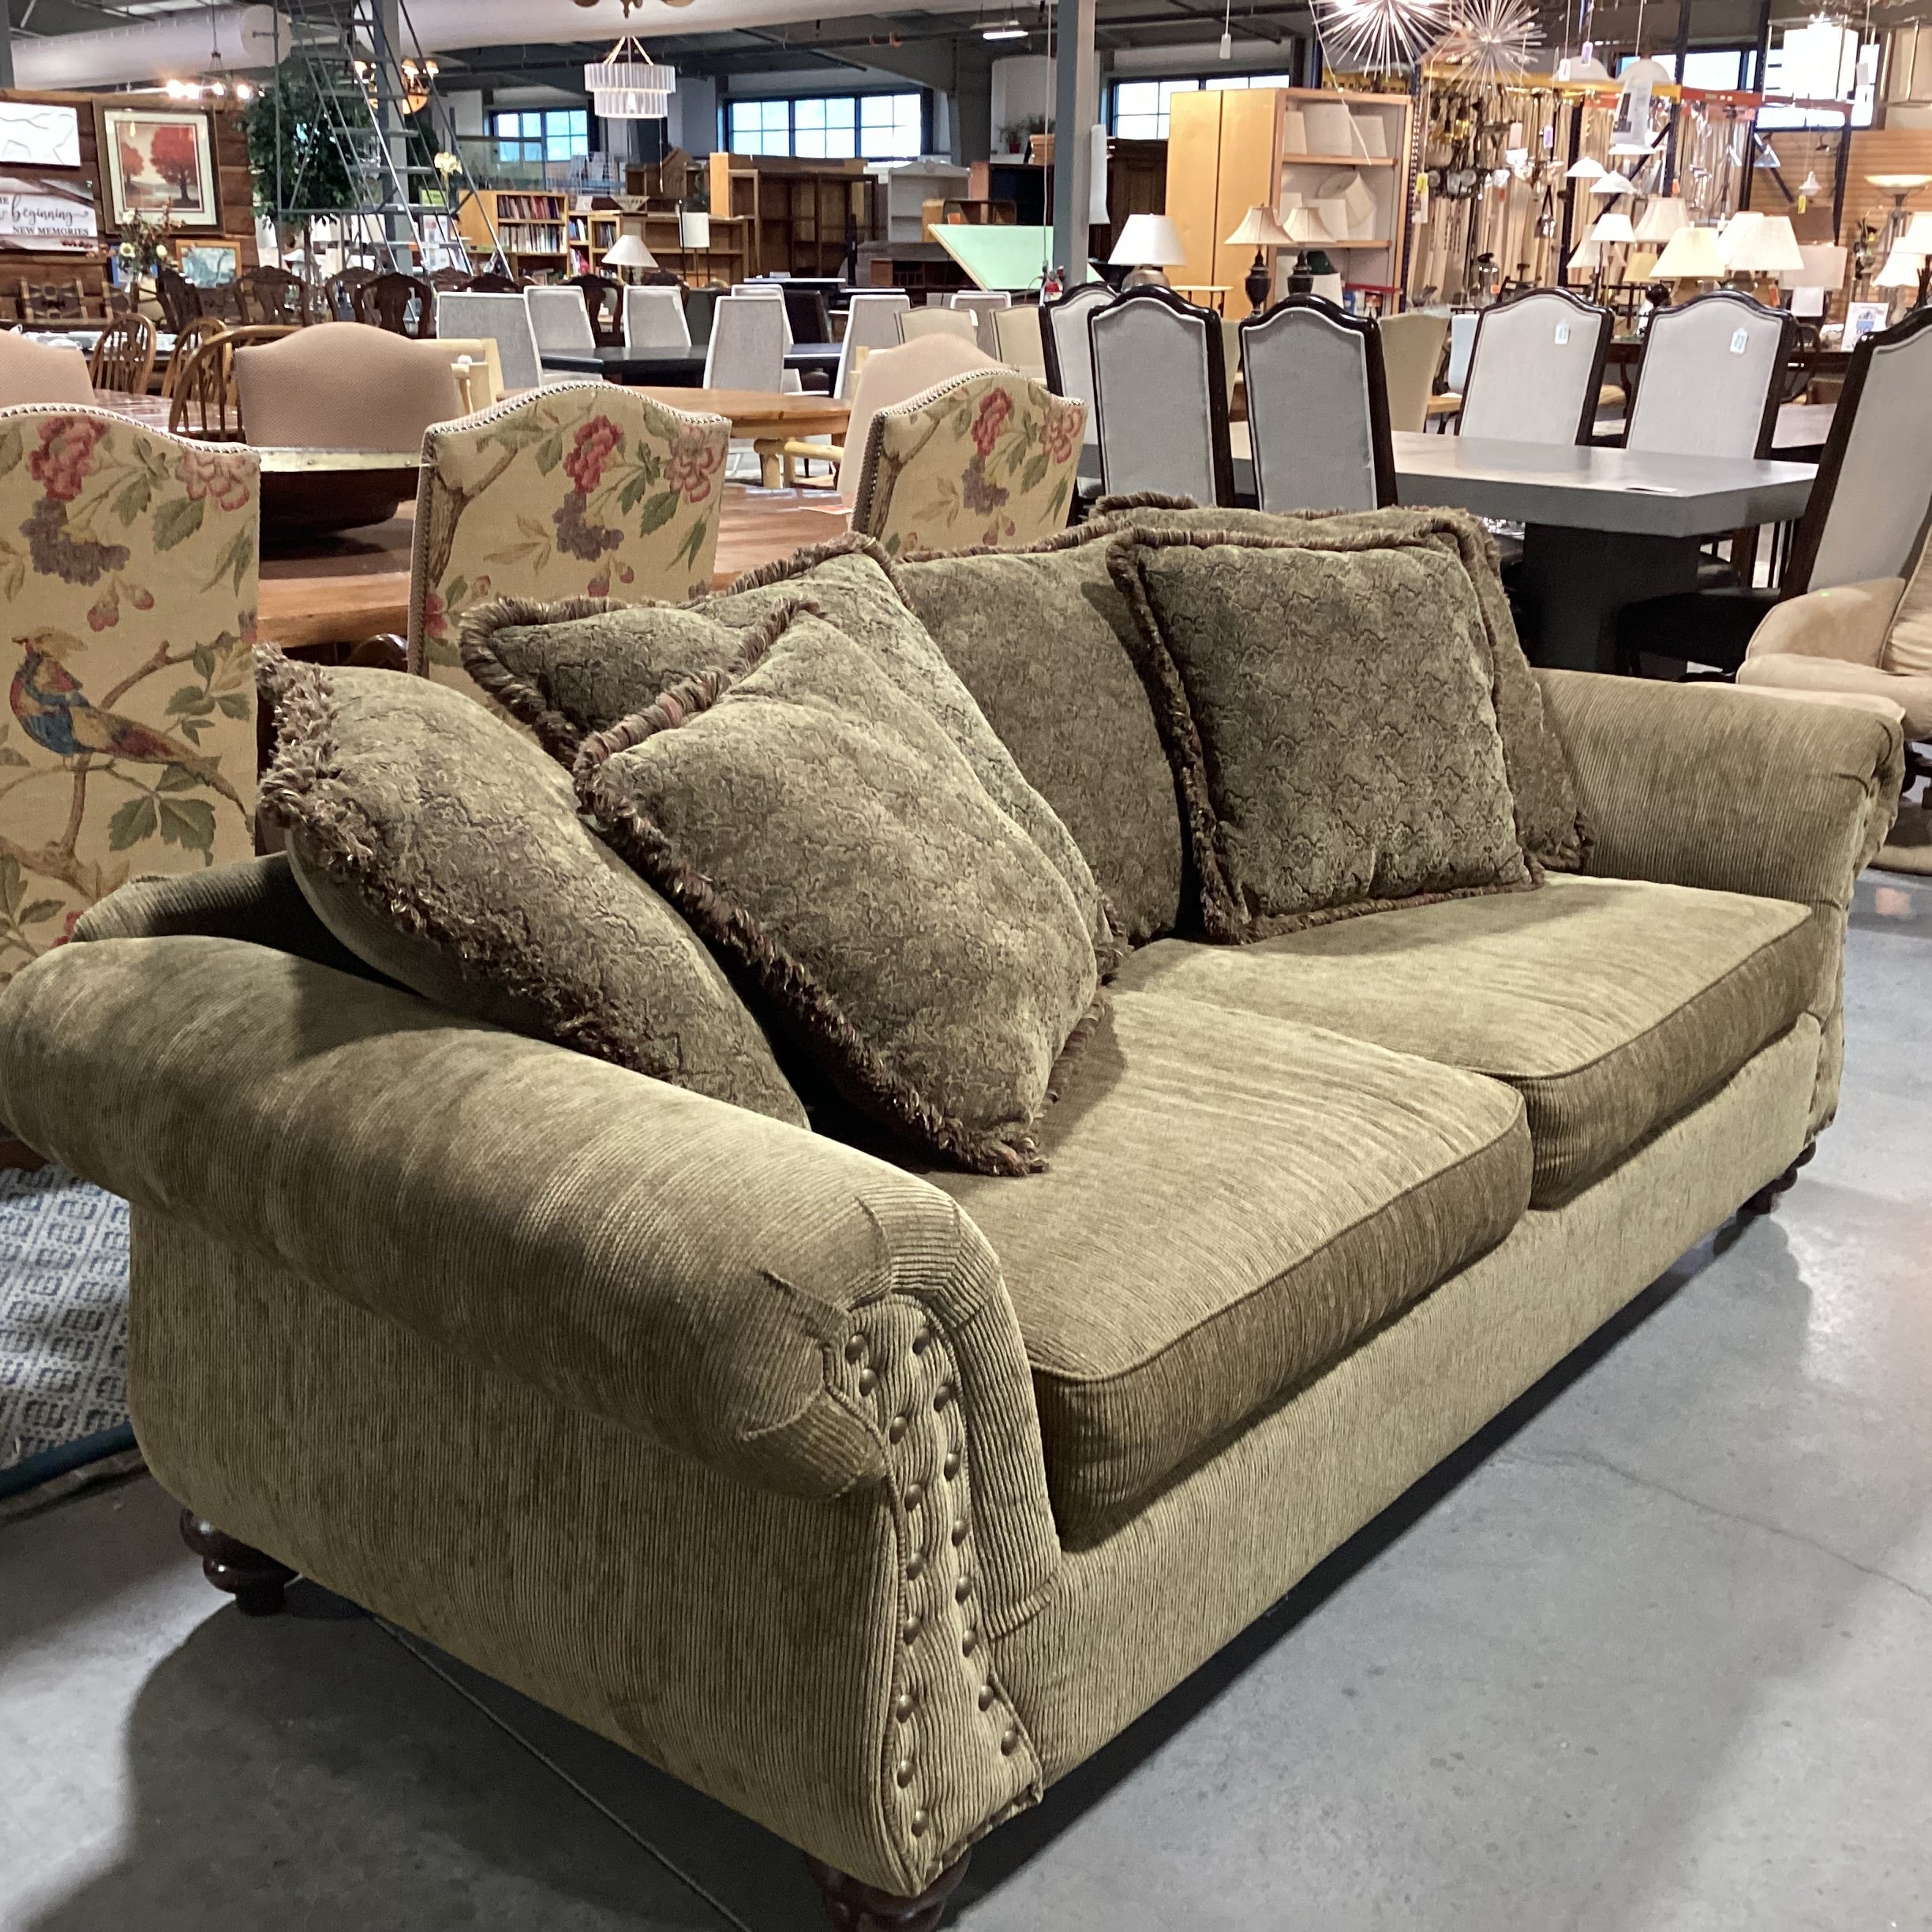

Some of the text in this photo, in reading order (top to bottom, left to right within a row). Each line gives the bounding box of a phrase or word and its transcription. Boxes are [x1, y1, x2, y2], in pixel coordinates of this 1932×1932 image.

[12, 194, 88, 227] beginning
[13, 226, 89, 236] NEW MEMORIES
